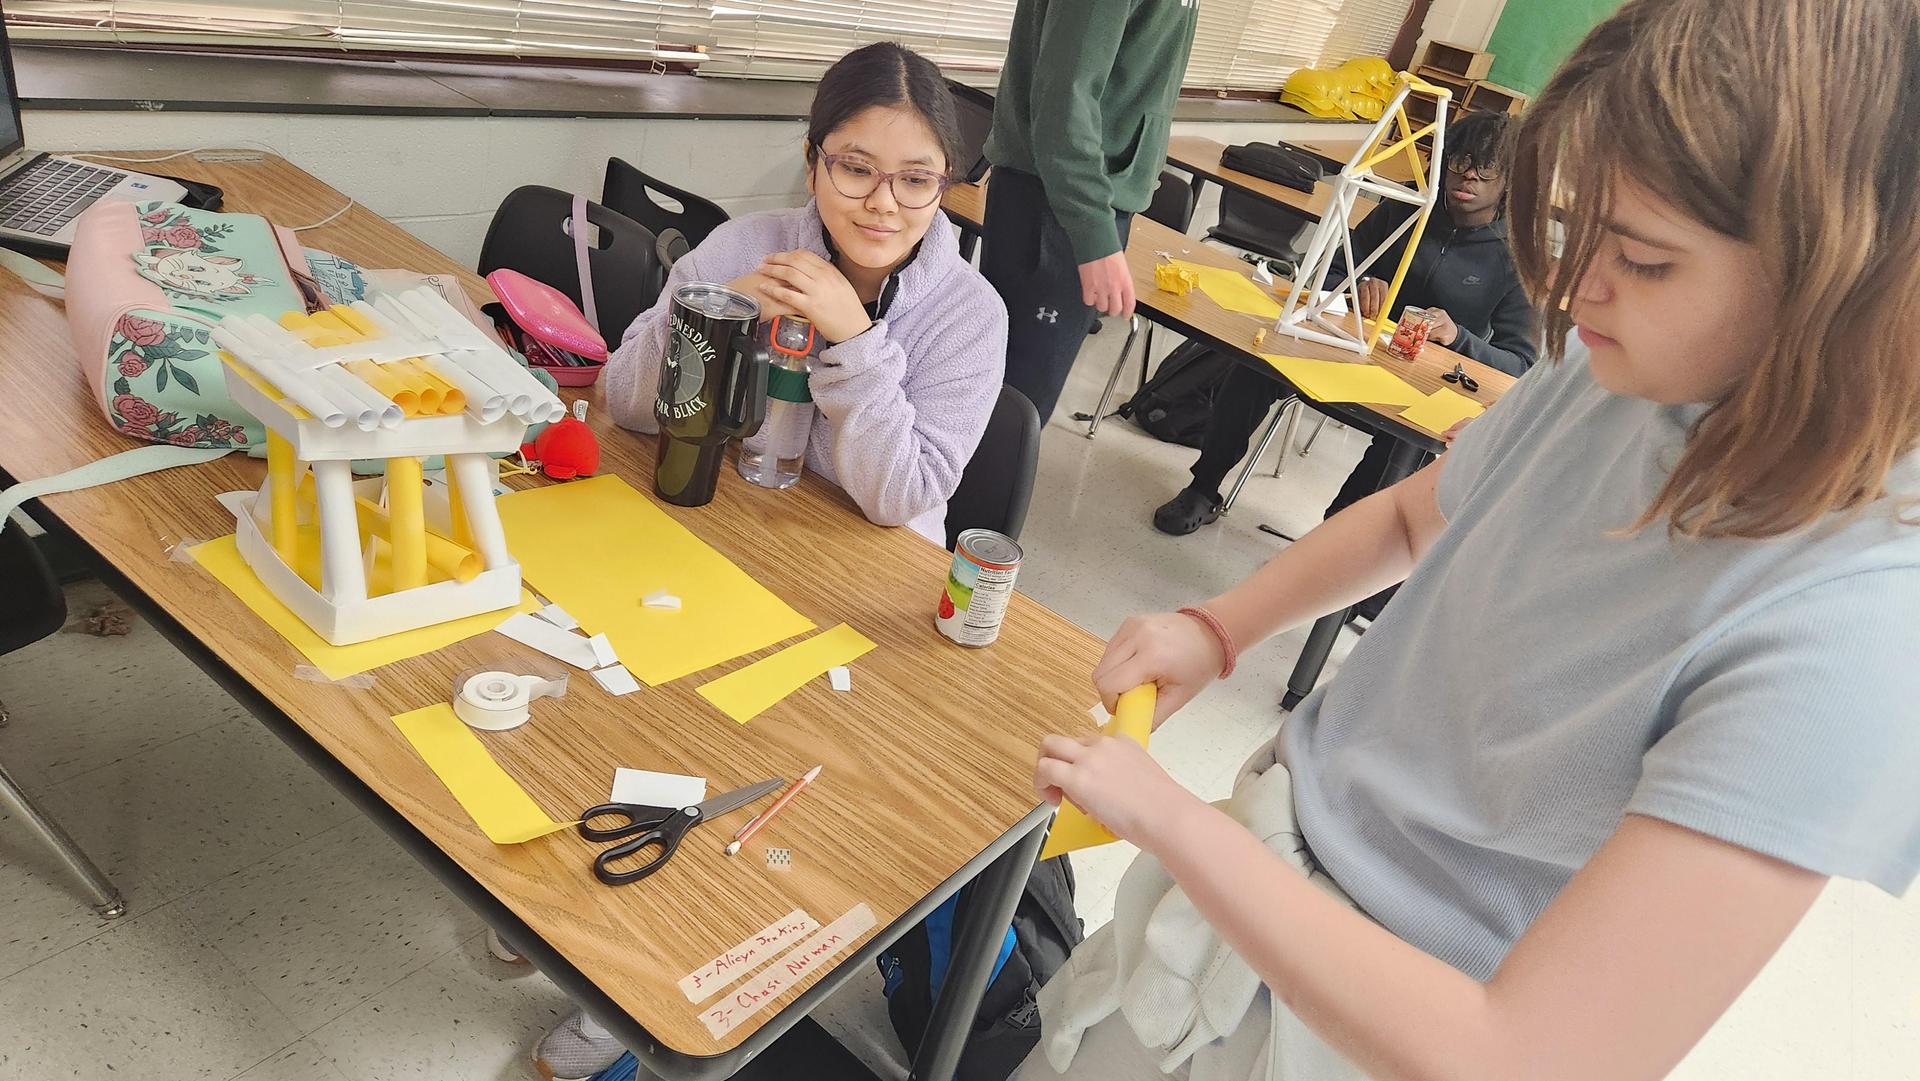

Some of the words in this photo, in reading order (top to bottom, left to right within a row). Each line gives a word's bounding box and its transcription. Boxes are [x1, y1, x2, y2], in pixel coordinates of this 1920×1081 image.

[668, 313, 717, 362] EDNESDAYS
[673, 396, 708, 419] BLACK
[980, 566, 1004, 575] Nutrition
[975, 582, 996, 590] Calories
